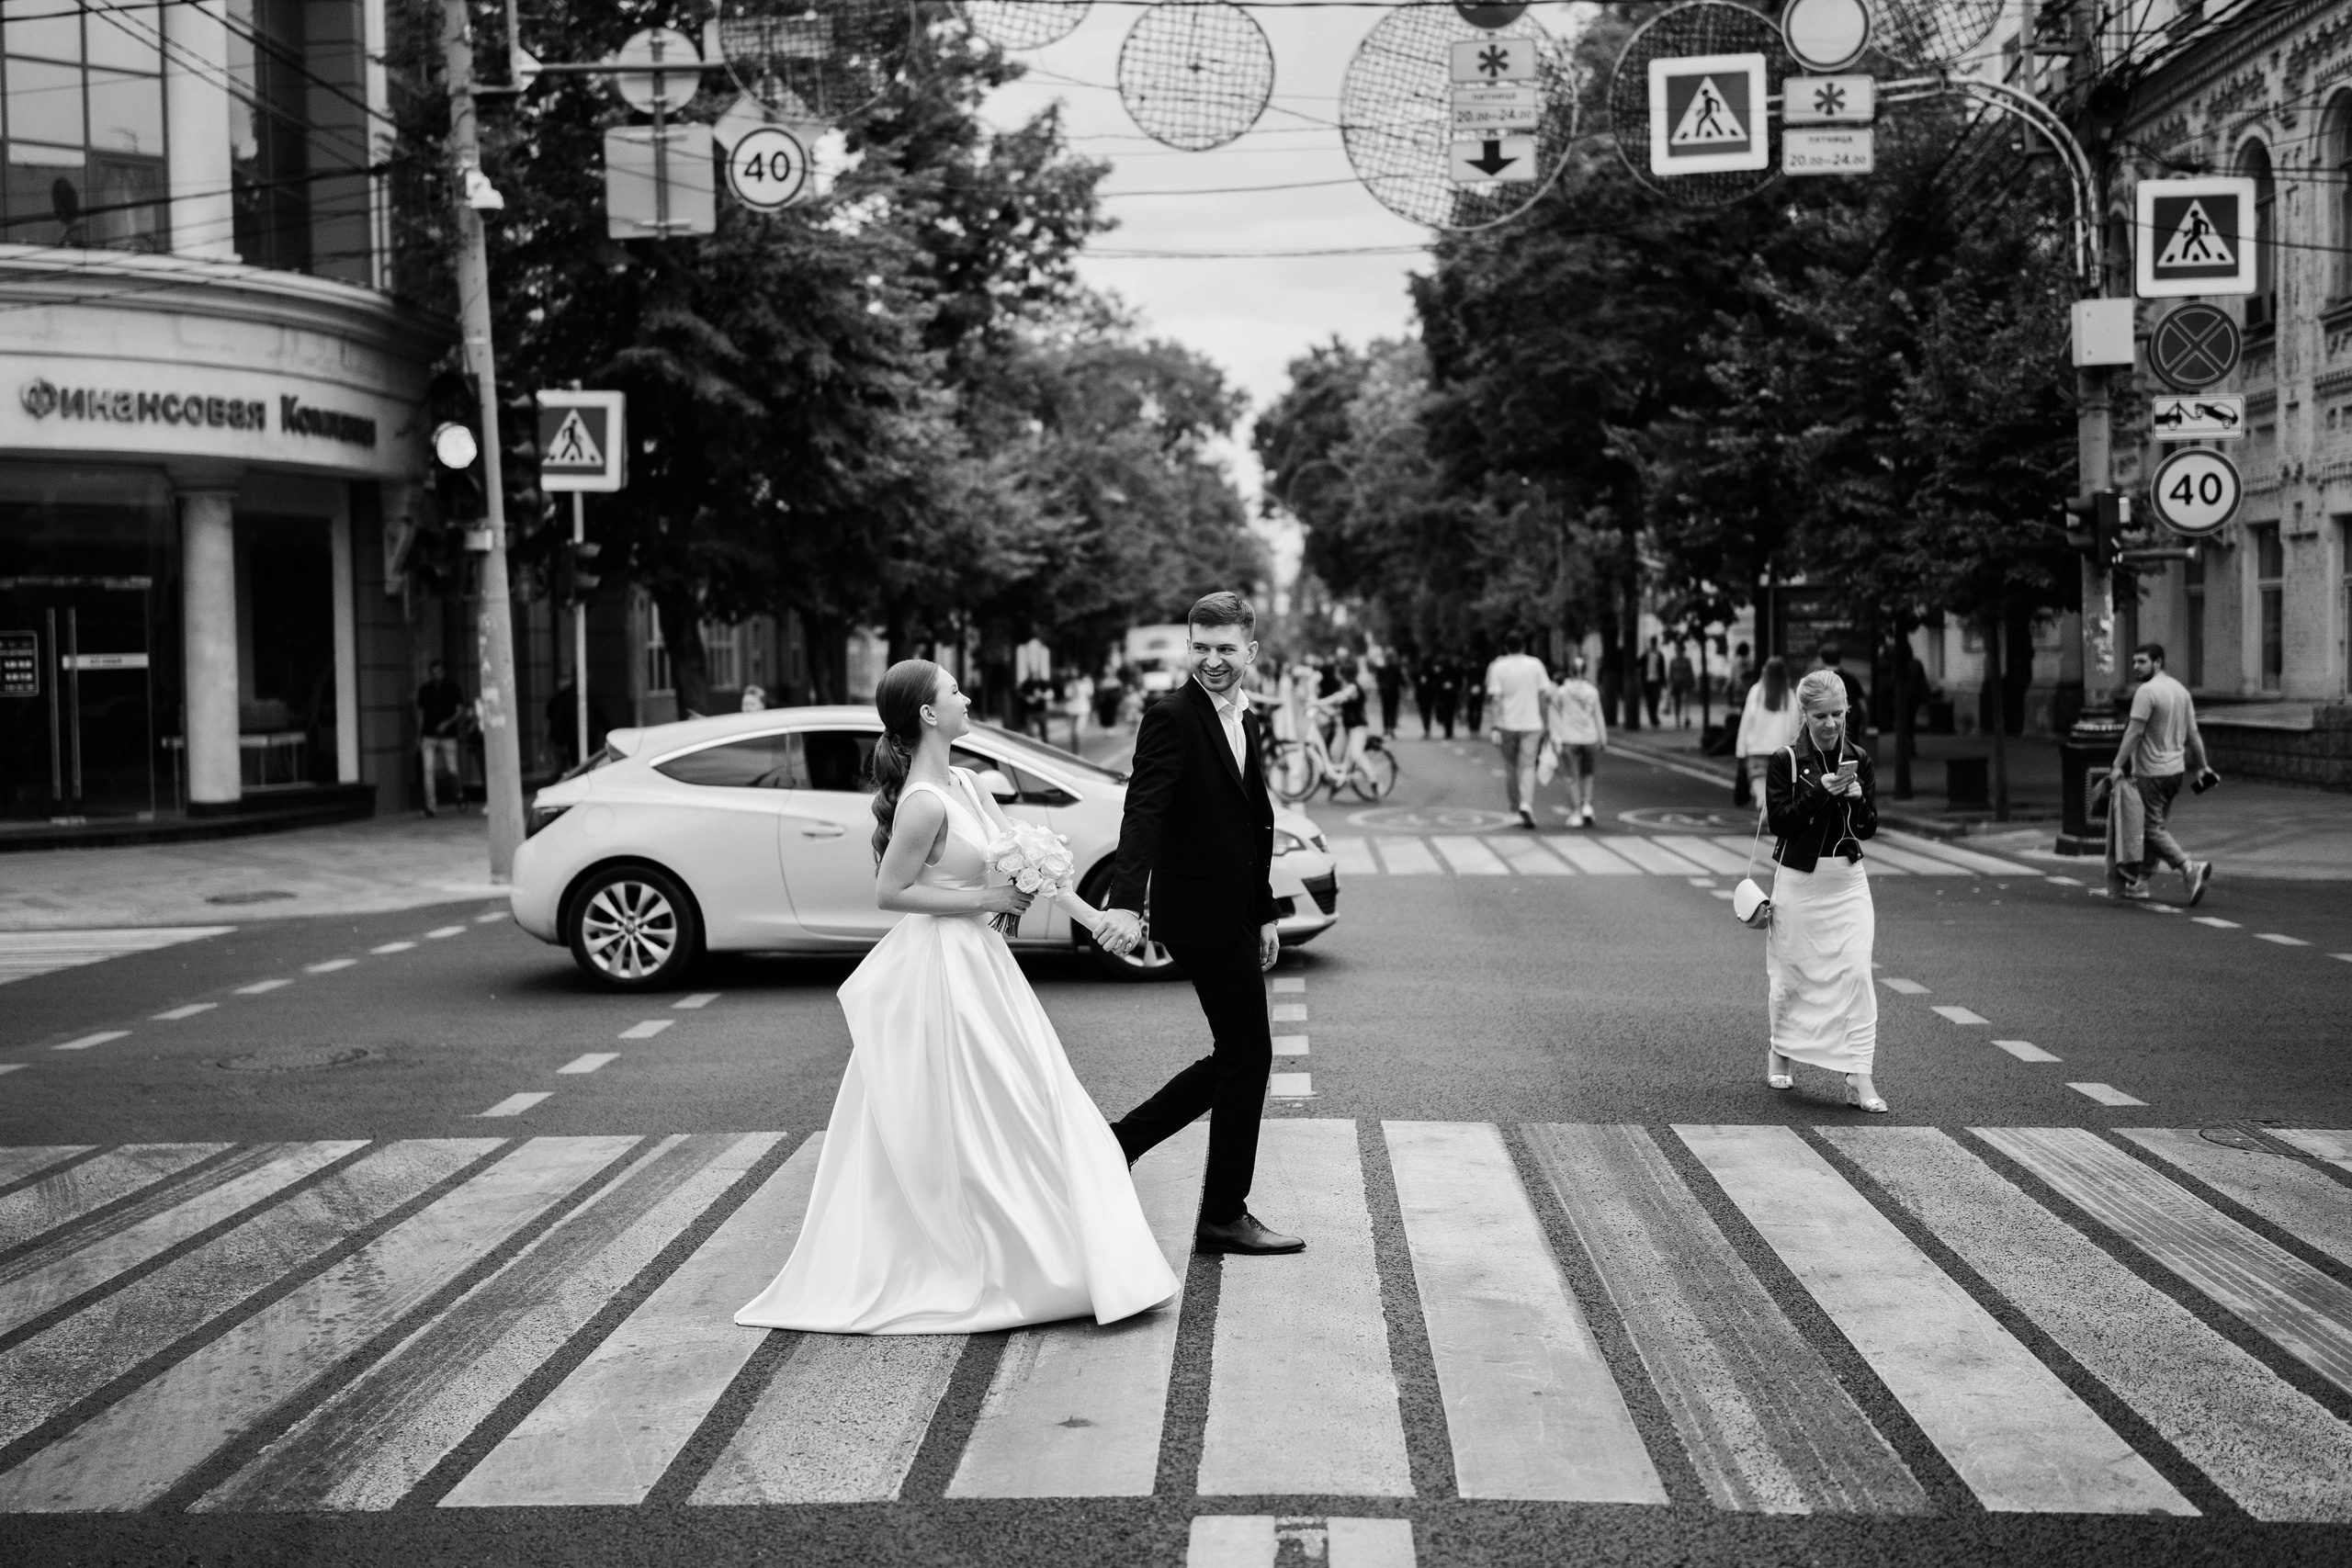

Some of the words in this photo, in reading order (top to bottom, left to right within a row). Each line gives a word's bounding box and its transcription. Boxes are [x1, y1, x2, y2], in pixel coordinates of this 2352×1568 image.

[743, 152, 790, 182] 40
[20, 377, 266, 432] Финансовая
[2168, 472, 2222, 506] 40
